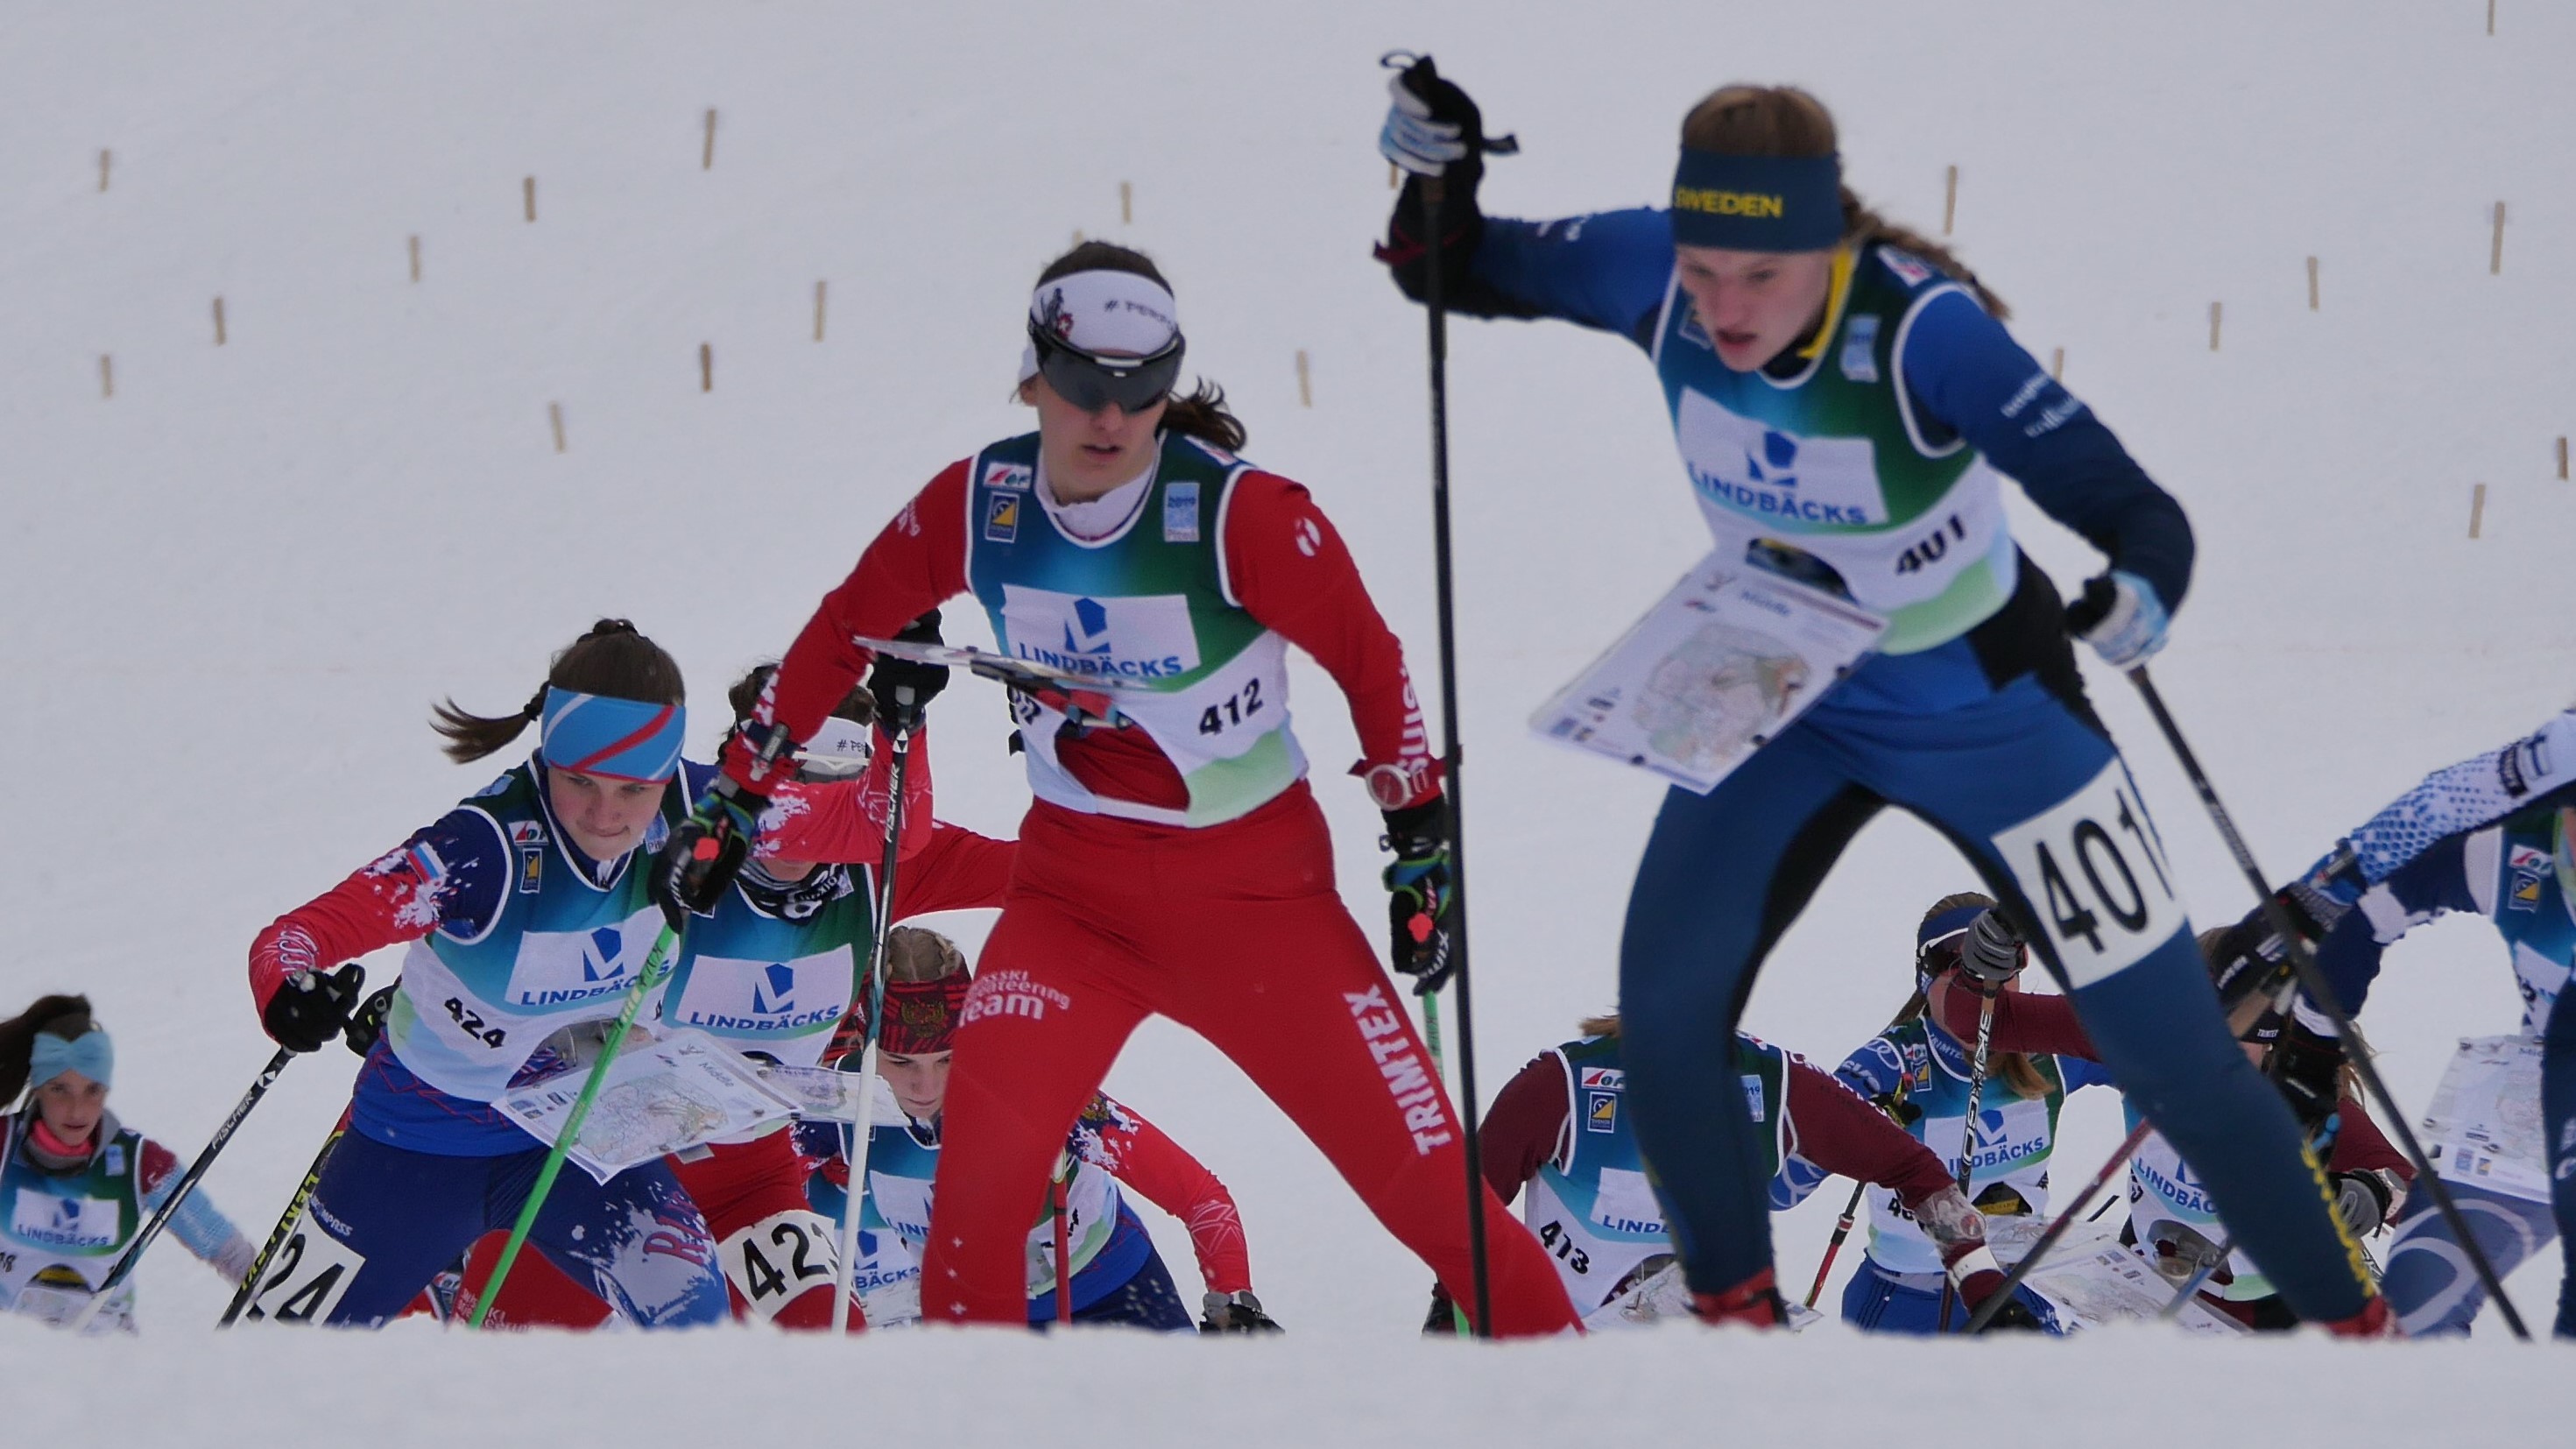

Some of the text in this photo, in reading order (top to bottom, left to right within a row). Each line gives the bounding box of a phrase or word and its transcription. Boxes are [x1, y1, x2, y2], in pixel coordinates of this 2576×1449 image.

[1674, 185, 1783, 218] SWEDEN
[1687, 460, 1868, 525] LINDBÄCKS
[1019, 642, 1182, 677] LINDBÄCKS
[1198, 677, 1264, 735] 412
[885, 764, 900, 843] FISCHER
[520, 958, 670, 1007] LINDBÄCS
[443, 996, 506, 1050] 424
[689, 1004, 840, 1031] LINDBÄCKS
[1343, 983, 1453, 1156] TRIMTEX
[1929, 1034, 1966, 1060] TRIMTE
[211, 1091, 255, 1150] FISCHER
[279, 1171, 320, 1233] LEKI
[2137, 1156, 2218, 1214] LINDBÄC
[18, 1223, 109, 1247] LINDBÄCKS
[1539, 1219, 1591, 1276] 413
[246, 1232, 347, 1323] 24
